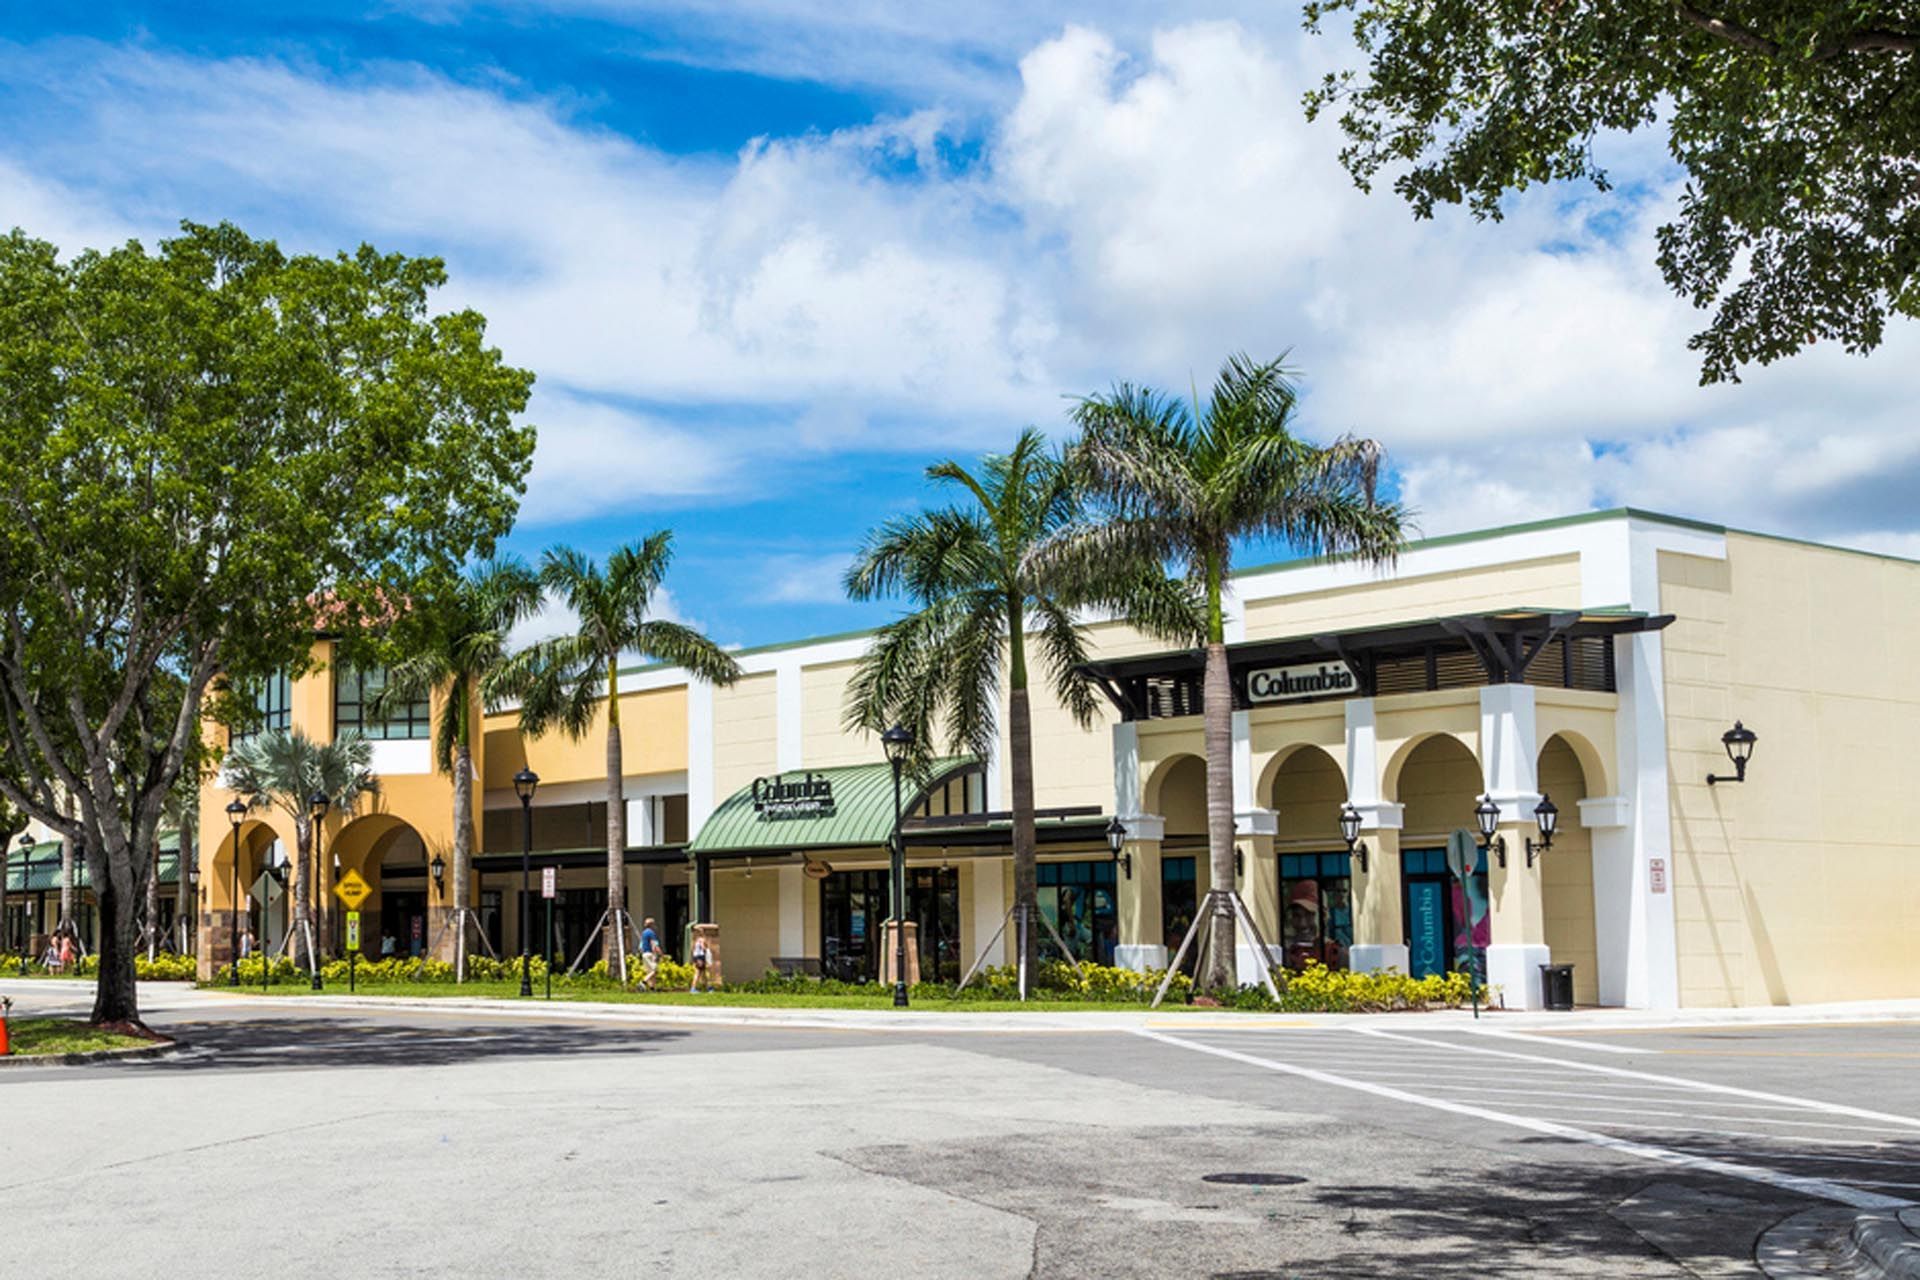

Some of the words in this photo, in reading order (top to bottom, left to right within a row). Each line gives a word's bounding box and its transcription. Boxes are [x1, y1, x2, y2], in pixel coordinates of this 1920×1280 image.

[1251, 665, 1353, 697] Columbia
[752, 773, 832, 803] Columbia
[1419, 888, 1435, 965] Columbia
